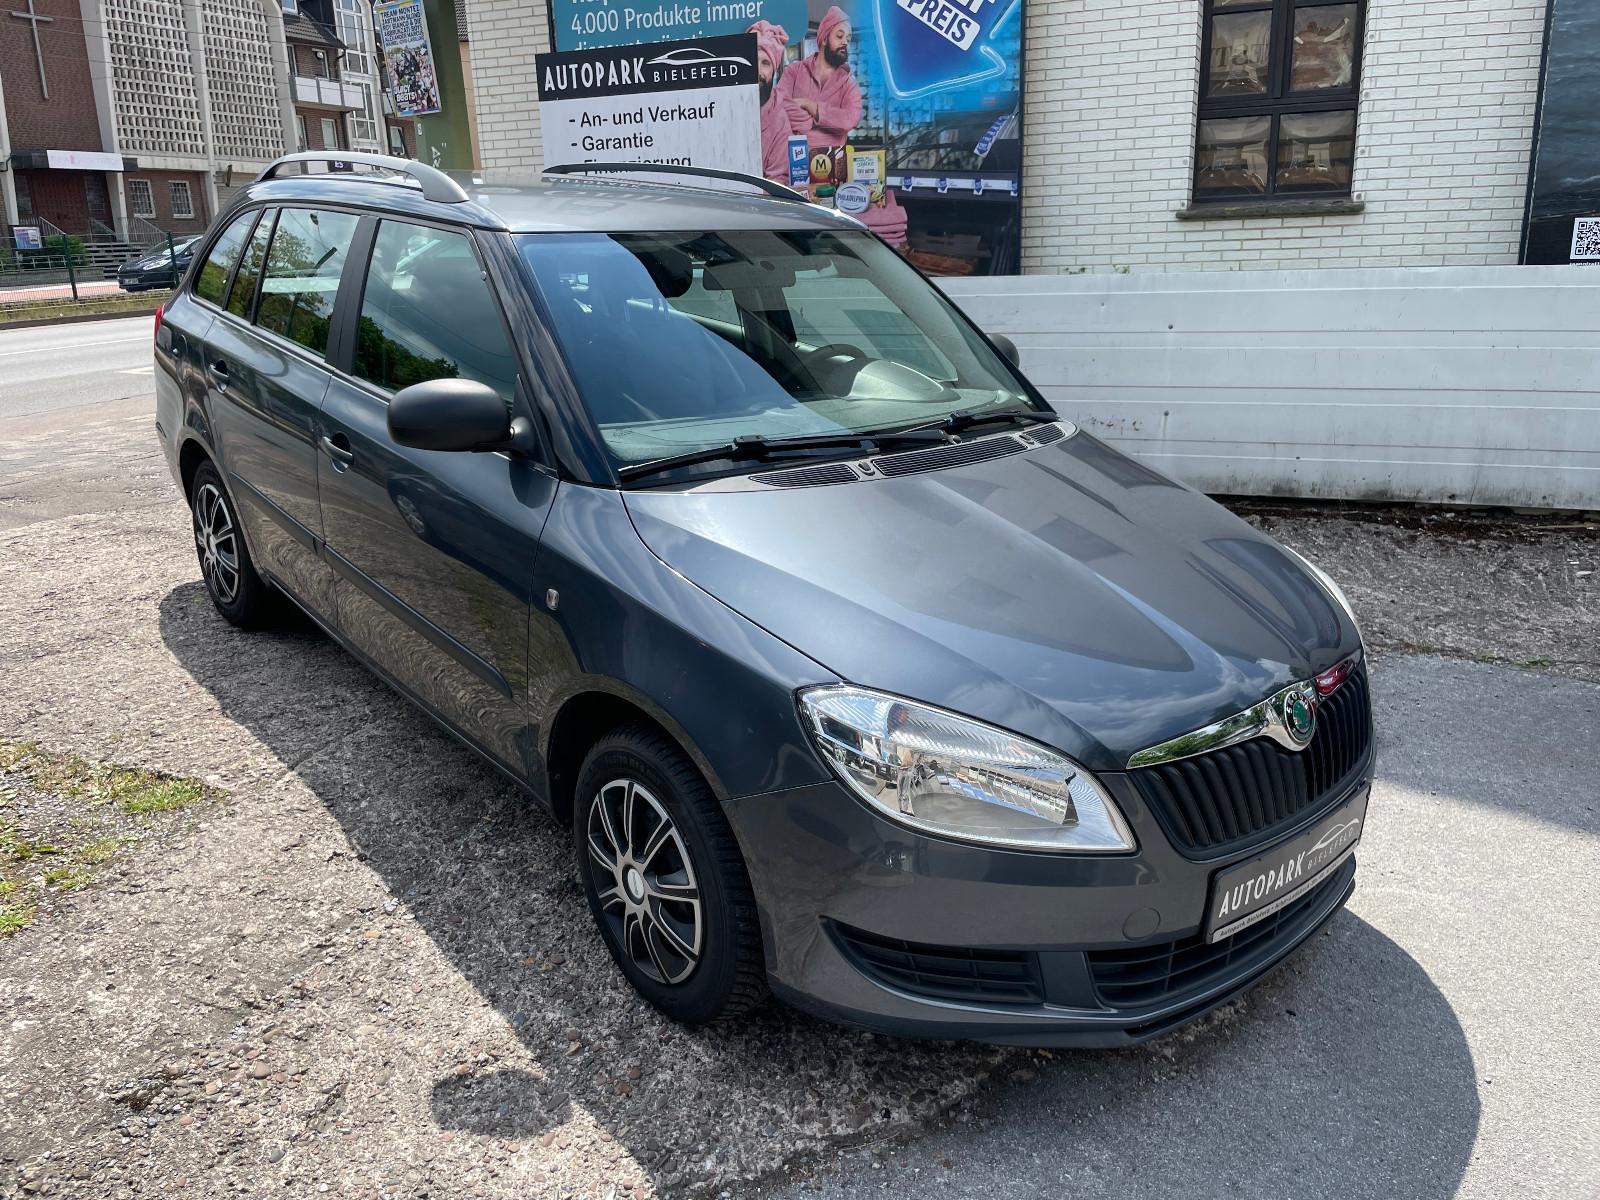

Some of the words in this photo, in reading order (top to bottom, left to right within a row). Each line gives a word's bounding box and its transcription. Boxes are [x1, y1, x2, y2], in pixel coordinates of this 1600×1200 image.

[398, 4, 419, 14] MONTEZ
[571, 9, 619, 35] 4.000
[623, 3, 701, 30] Produkte
[706, 0, 764, 22] immer
[544, 57, 646, 92] AUTOPARK
[653, 64, 738, 83] BIELEFELD
[580, 111, 608, 128] An-
[612, 107, 644, 126] und
[648, 102, 716, 123] Verkauf
[582, 132, 654, 151] Garantie
[815, 159, 827, 170] M
[1217, 850, 1306, 919] AUTOPARK
[1307, 826, 1353, 871] BIELEFELD
